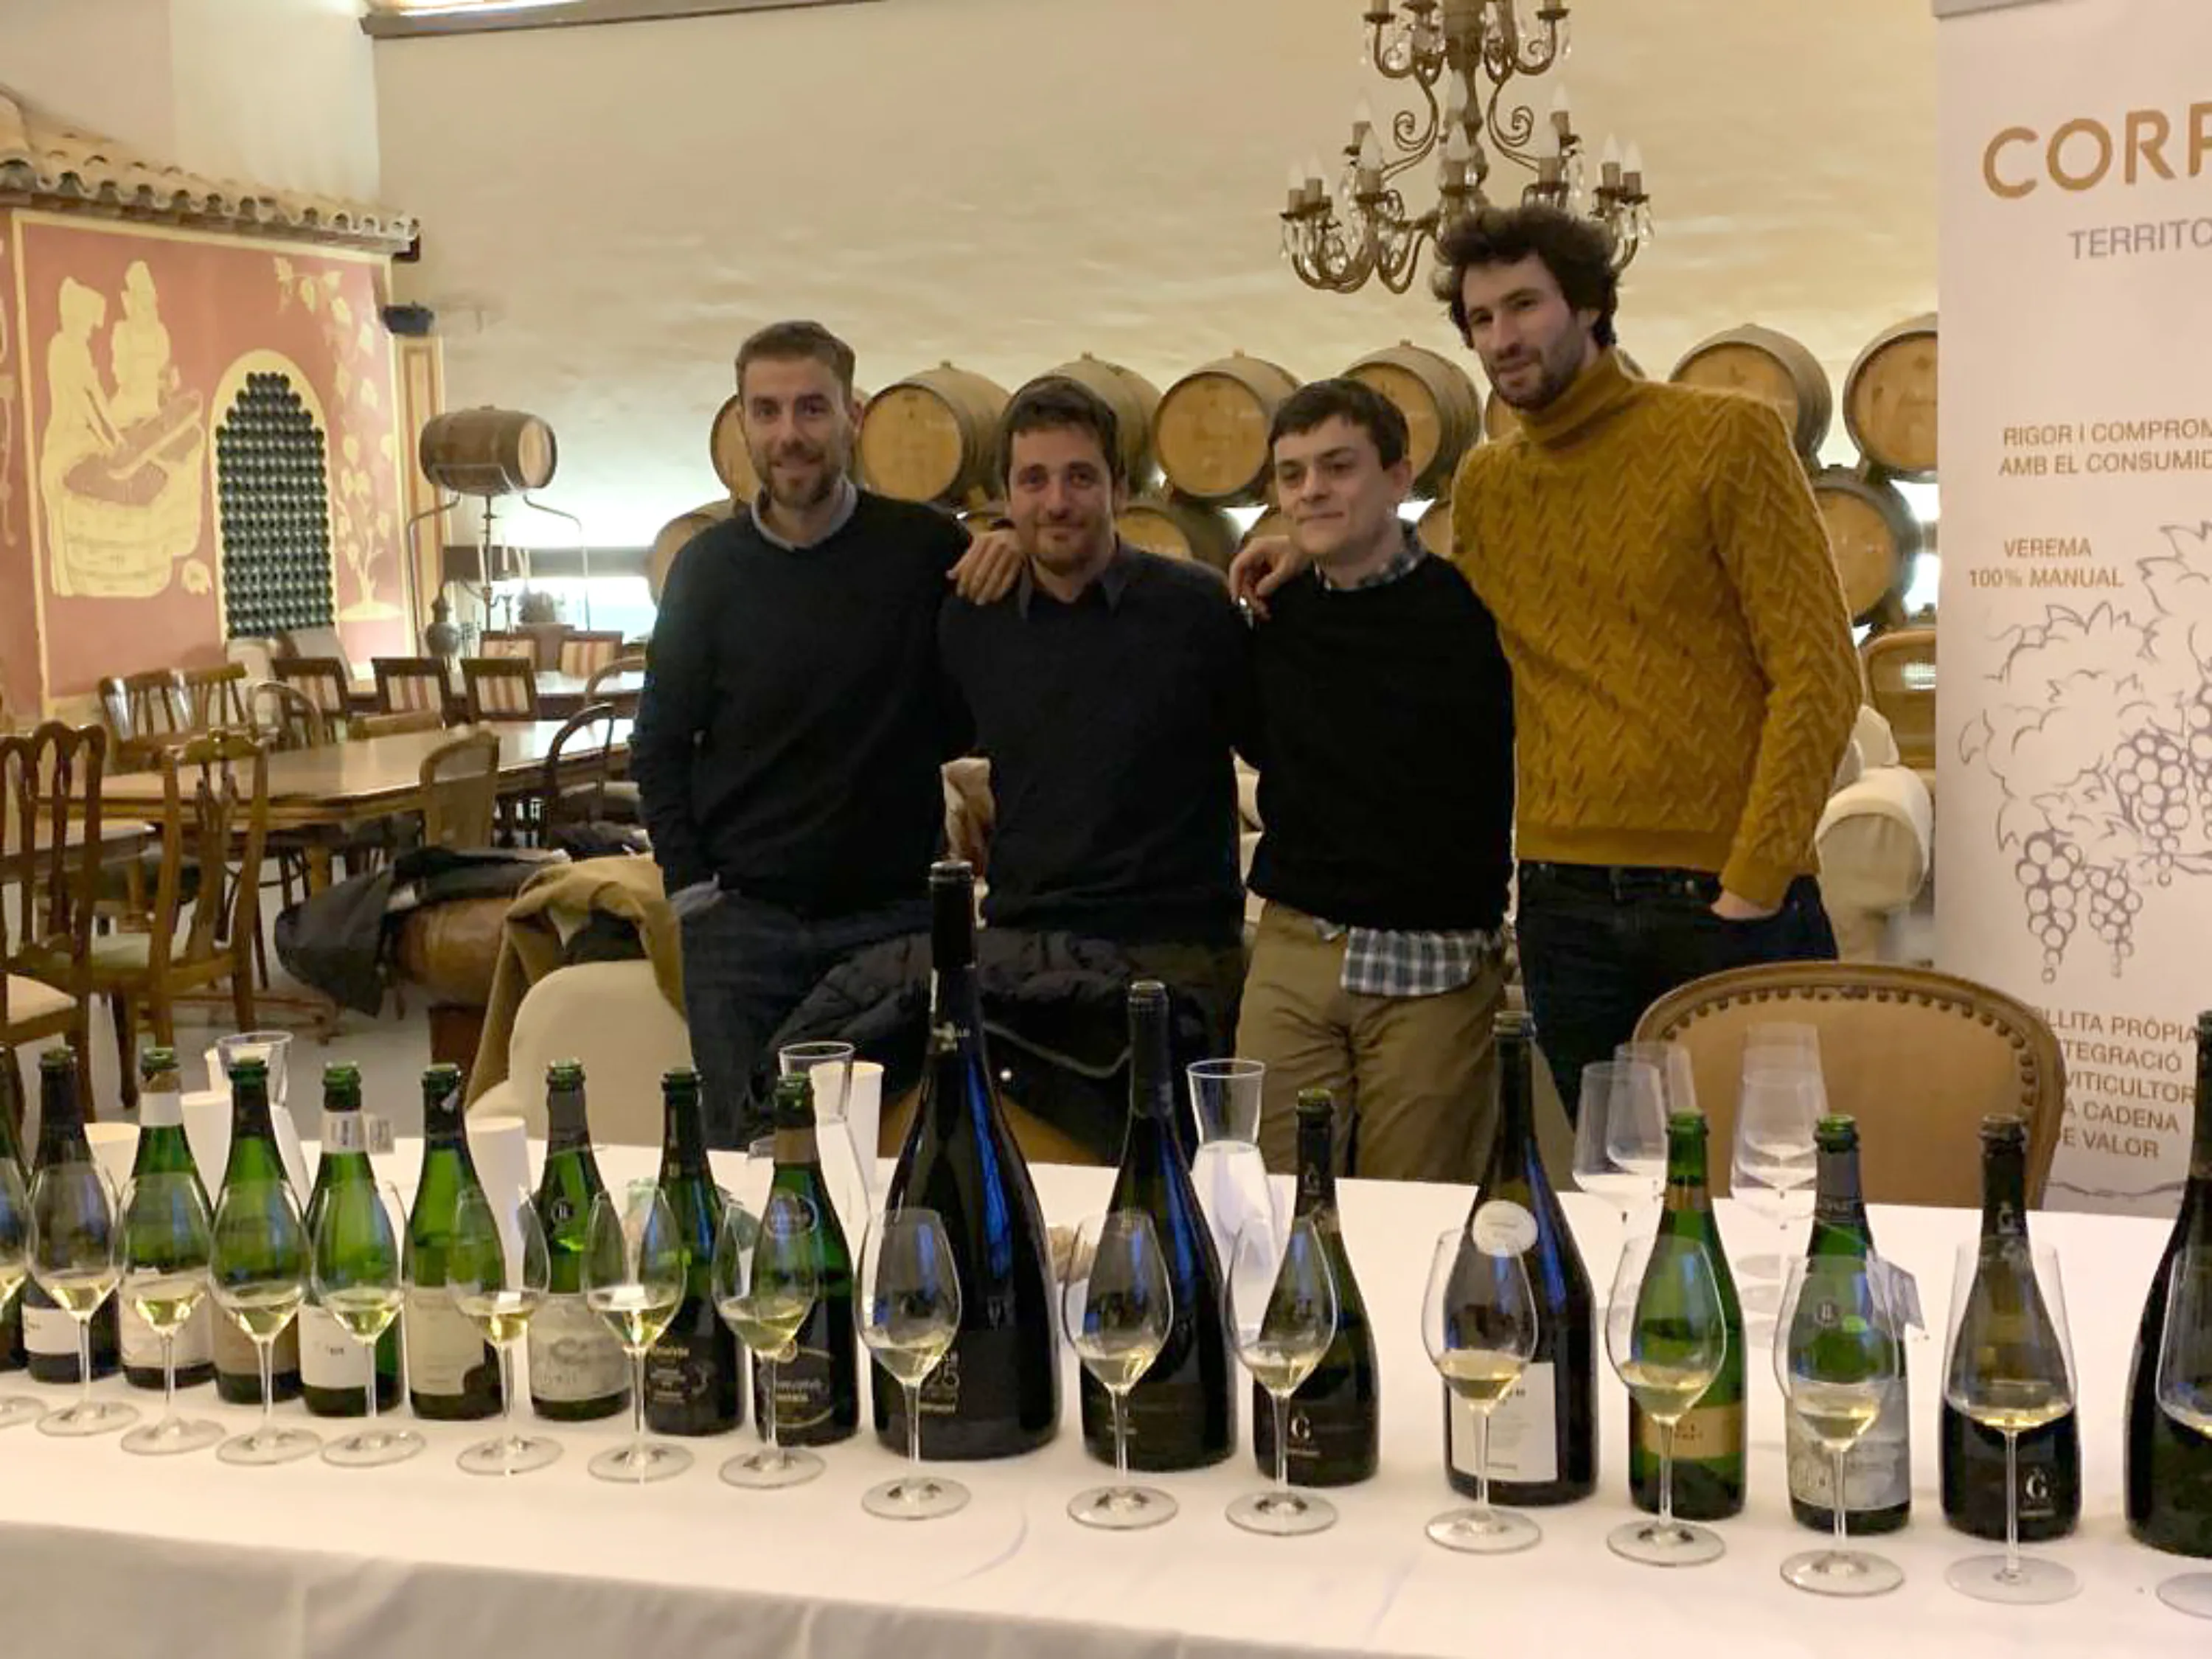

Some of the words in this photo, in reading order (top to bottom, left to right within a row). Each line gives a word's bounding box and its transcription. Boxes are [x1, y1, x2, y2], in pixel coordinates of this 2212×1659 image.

[2003, 425, 2073, 447] RIGOR
[2079, 422, 2085, 442] I
[1998, 455, 2048, 476] AMB
[2054, 453, 2079, 473] EL
[2004, 537, 2093, 558] VEREMA
[1969, 567, 2023, 588] 100%
[2030, 566, 2125, 588] MANUAL
[2062, 1038, 2183, 1074] TEGRACIÓ
[2084, 1100, 2180, 1133] CADENA
[2082, 1130, 2159, 1160] VALOR
